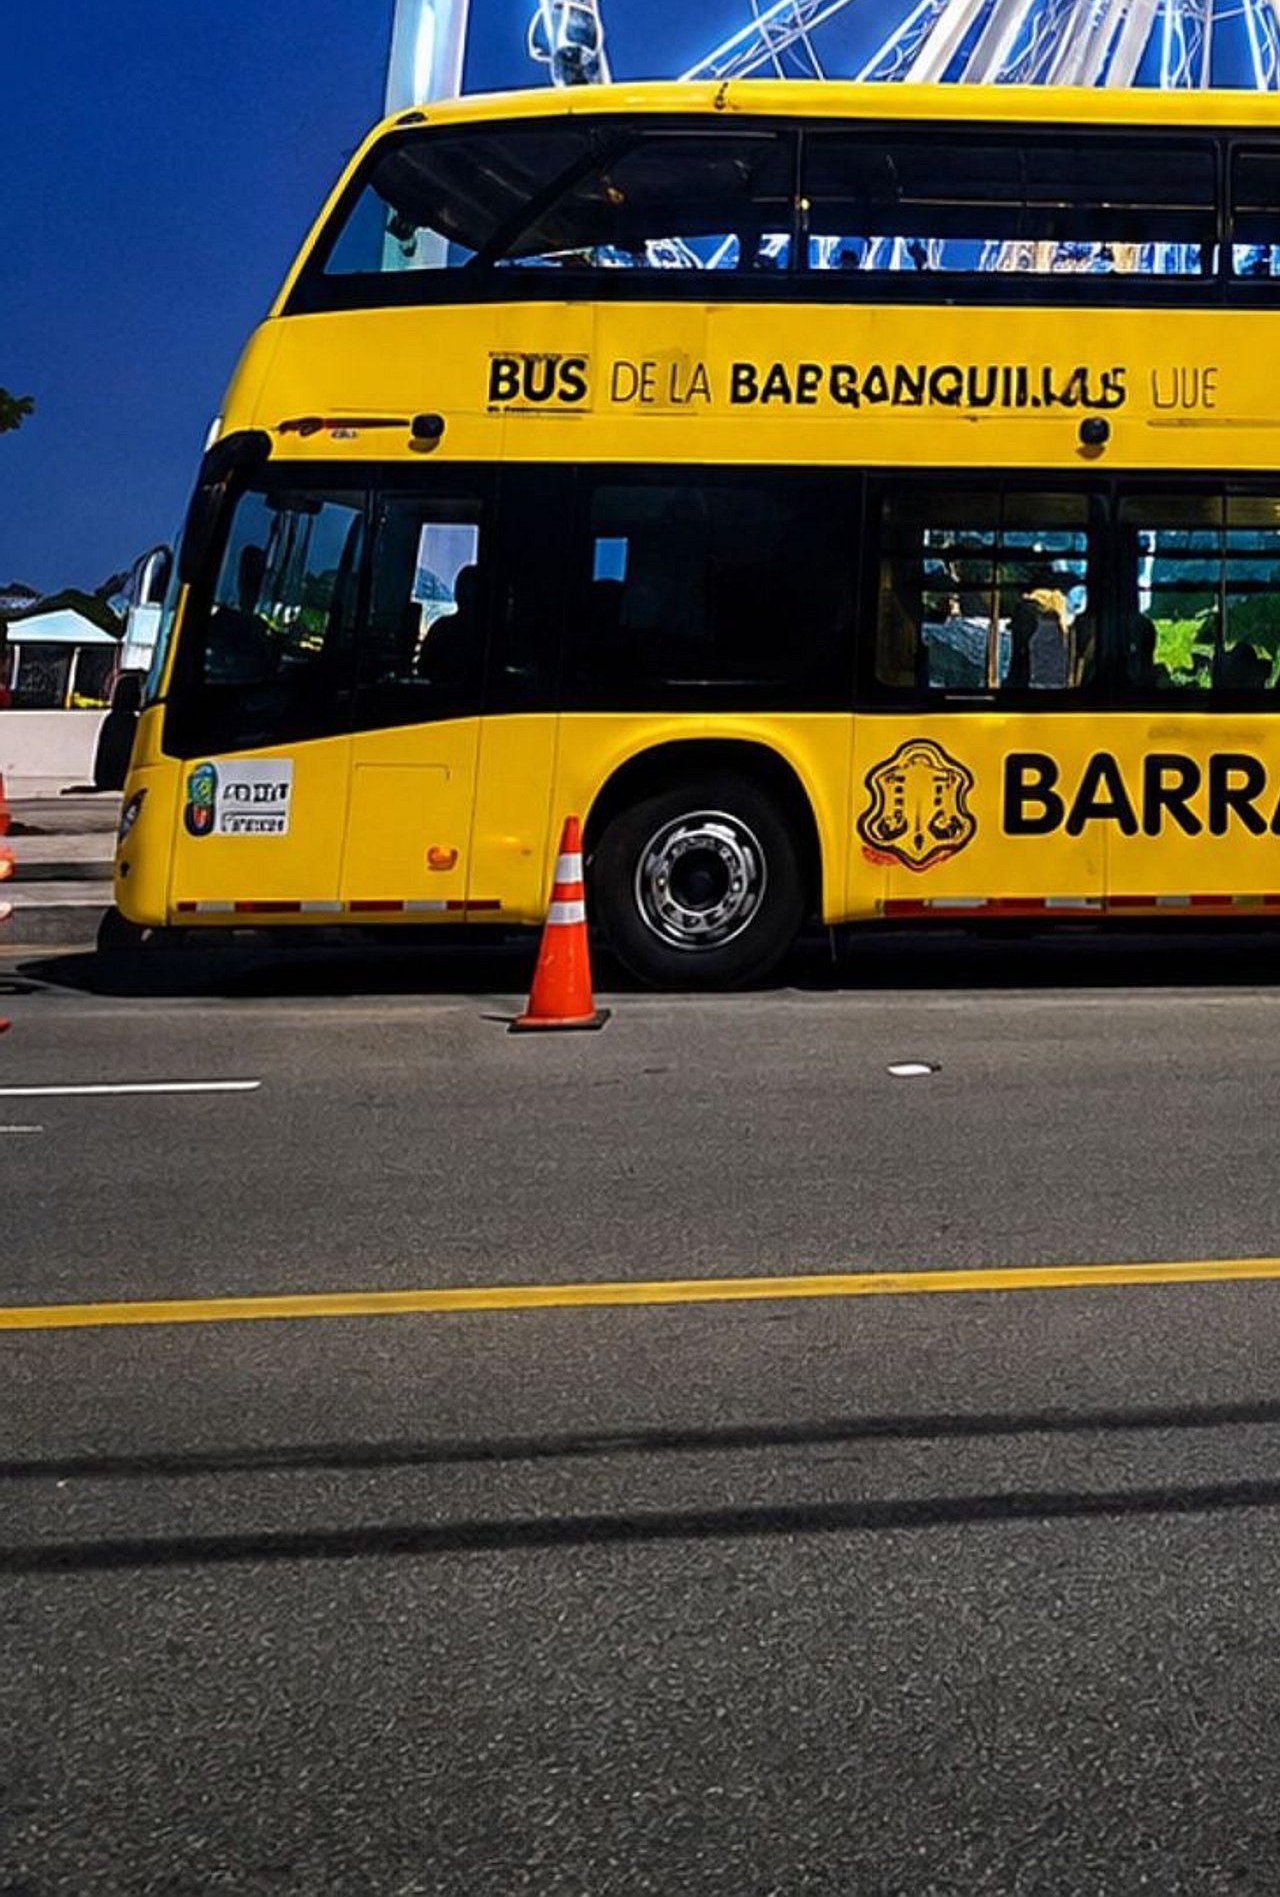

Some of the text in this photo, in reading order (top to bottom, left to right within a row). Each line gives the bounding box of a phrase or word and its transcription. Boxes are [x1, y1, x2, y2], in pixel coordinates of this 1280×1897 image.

[488, 357, 588, 403] BUS
[611, 361, 657, 403] DE
[670, 361, 712, 404] LA
